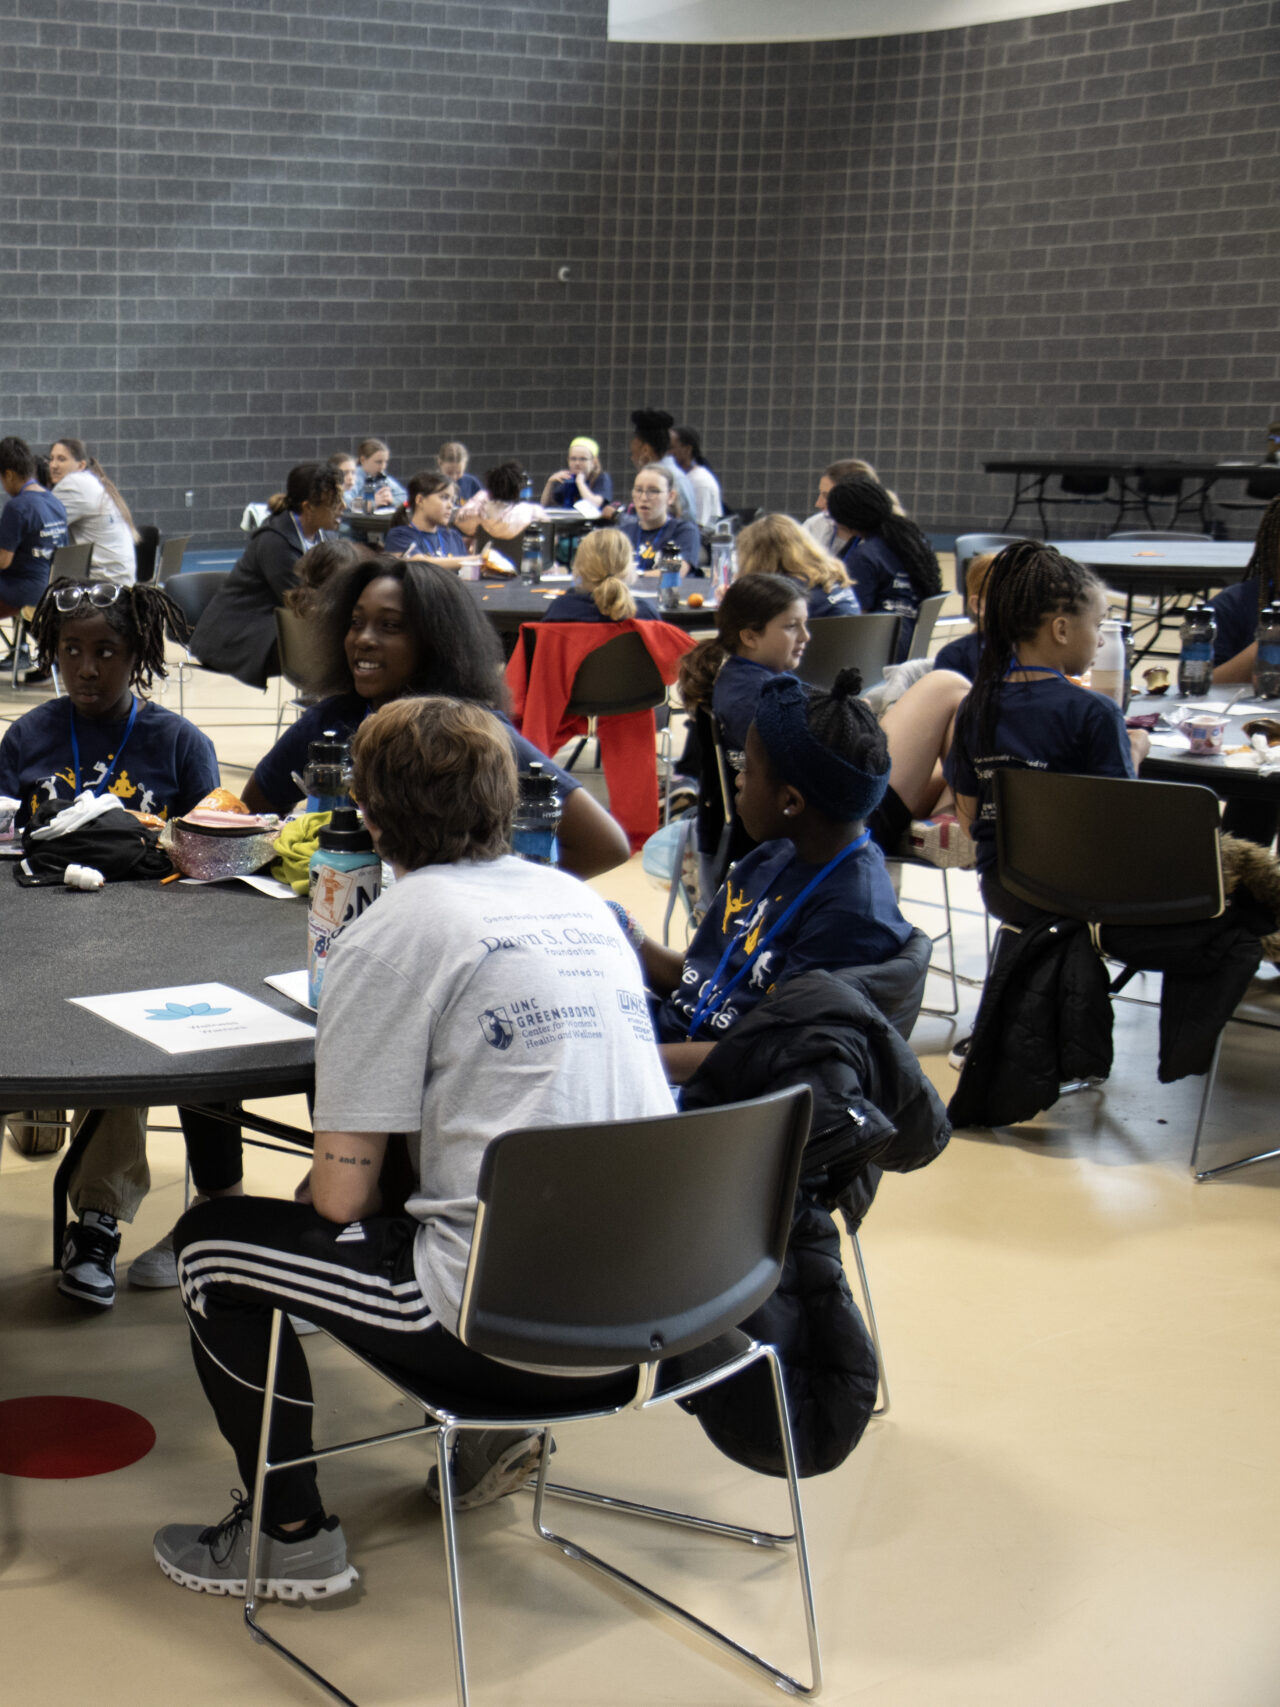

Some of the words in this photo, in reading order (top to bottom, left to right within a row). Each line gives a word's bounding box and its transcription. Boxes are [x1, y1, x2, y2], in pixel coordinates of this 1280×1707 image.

[482, 911, 538, 924] Generously
[538, 911, 585, 922] supported
[478, 932, 543, 954] Dawn
[541, 928, 563, 946] S.
[544, 946, 597, 957] Foundation
[558, 968, 591, 977] Hosted
[593, 968, 605, 979] by
[509, 997, 540, 1015] UNC
[516, 1005, 596, 1028] GREENSBORO
[521, 1023, 551, 1039] Center
[550, 1021, 565, 1032] for
[524, 1034, 557, 1050] Health
[556, 1029, 572, 1041] and
[572, 1028, 603, 1040] Wellness
[339, 1156, 356, 1165] and
